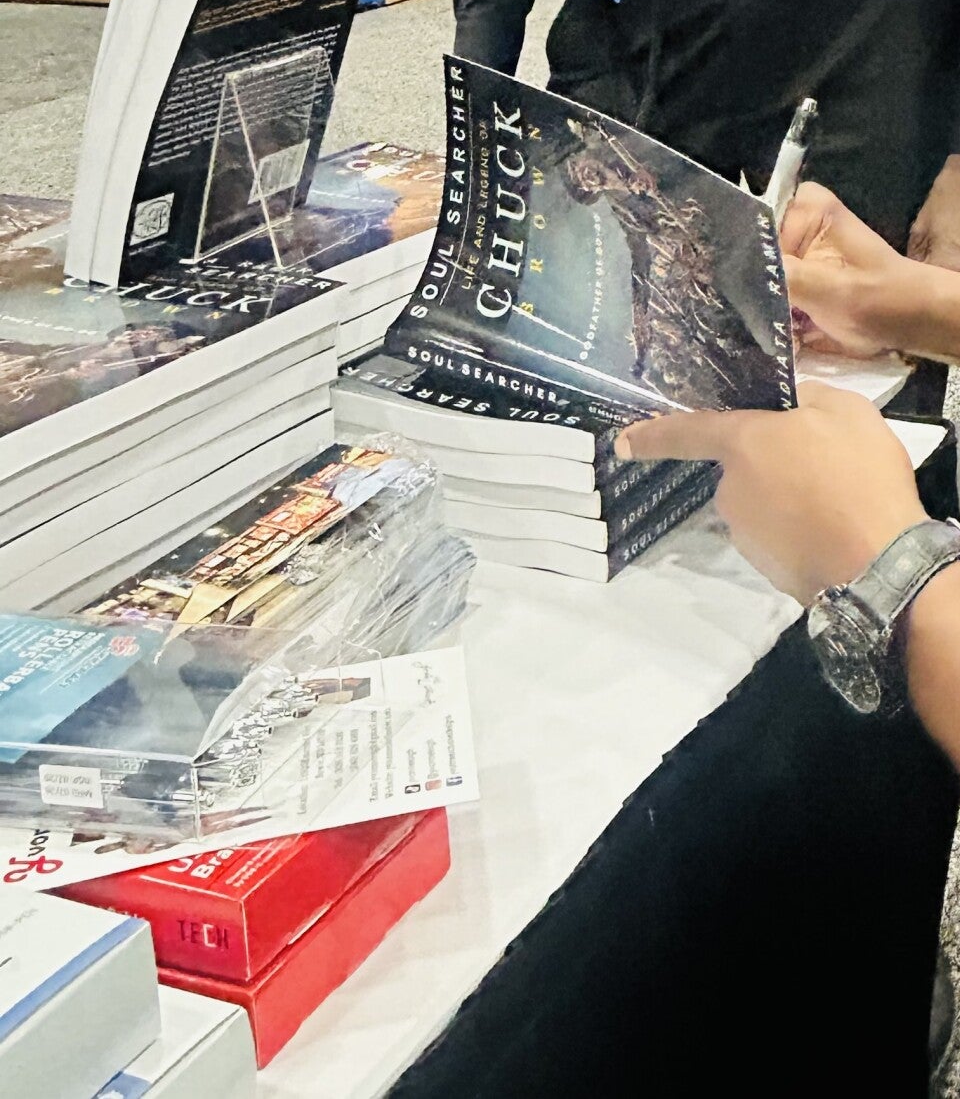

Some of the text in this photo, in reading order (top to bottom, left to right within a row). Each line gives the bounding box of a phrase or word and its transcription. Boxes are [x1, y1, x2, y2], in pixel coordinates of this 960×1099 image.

[410, 65, 467, 319] SOUL SEARCHER
[476, 101, 526, 319] CHUCK
[461, 254, 480, 291] LIFE
[473, 214, 486, 249] AND
[62, 277, 273, 313] CHUCK
[341, 366, 491, 413] SEARCHER
[408, 346, 558, 404] SOUL SEARCHER
[508, 407, 581, 426] SOUL
[176, 919, 230, 950] TECH
